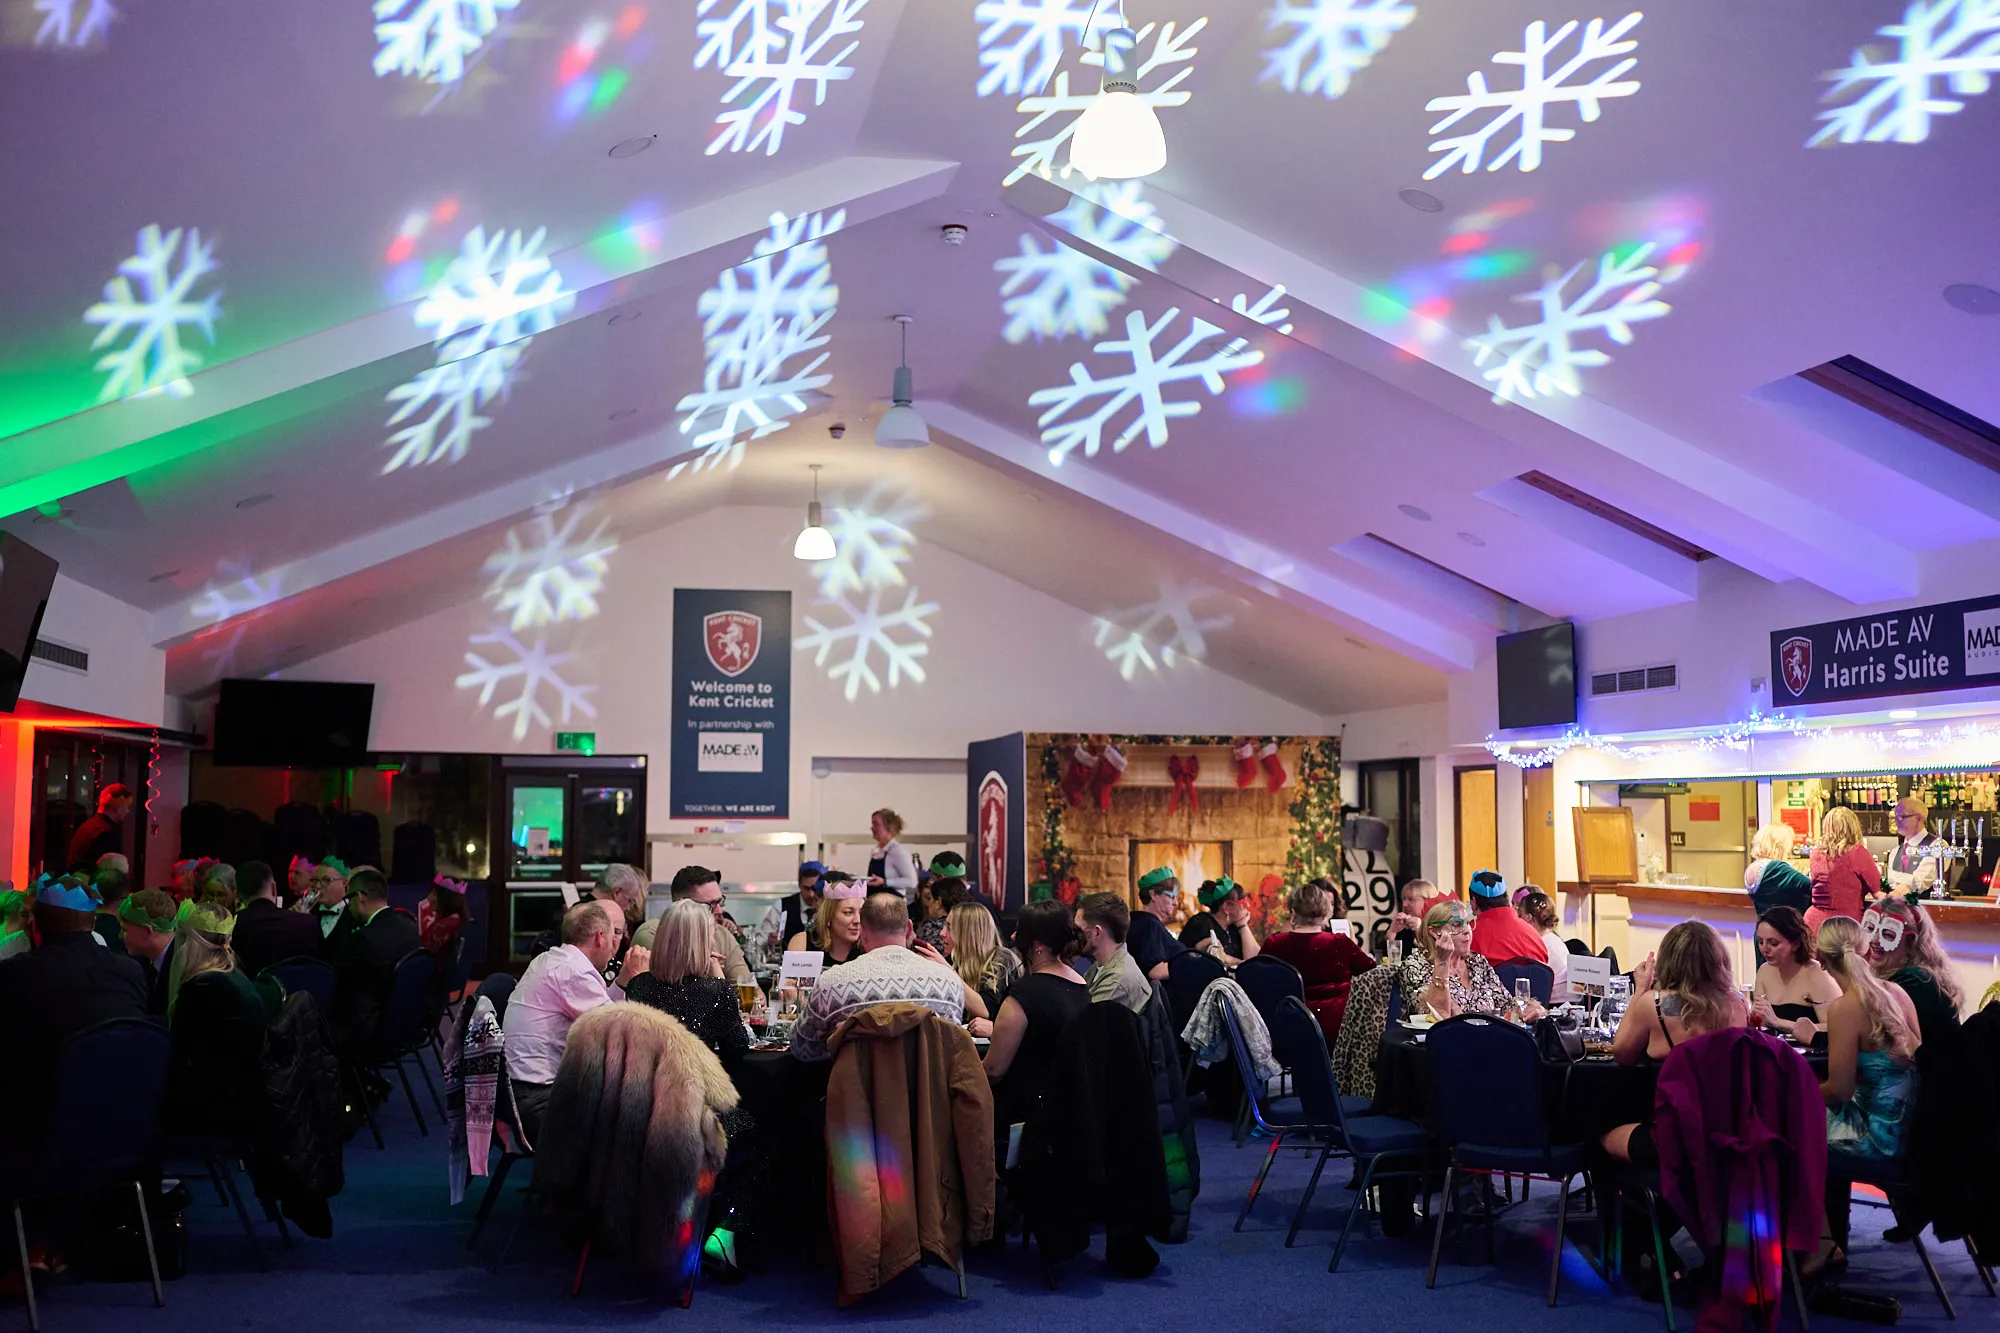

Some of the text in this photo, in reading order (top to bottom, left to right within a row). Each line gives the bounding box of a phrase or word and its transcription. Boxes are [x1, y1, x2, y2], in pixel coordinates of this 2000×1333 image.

[1834, 613, 1934, 654] MADE AV
[1824, 649, 1950, 689] Harris Suite
[690, 680, 773, 694] Welcome to
[688, 694, 774, 708] Kent Cricket
[687, 719, 775, 730] In partnership with
[702, 743, 742, 756] MADE
[725, 804, 738, 813] WE
[739, 804, 755, 813] ARE
[755, 804, 776, 813] KENT
[1670, 834, 1683, 845] ULL
